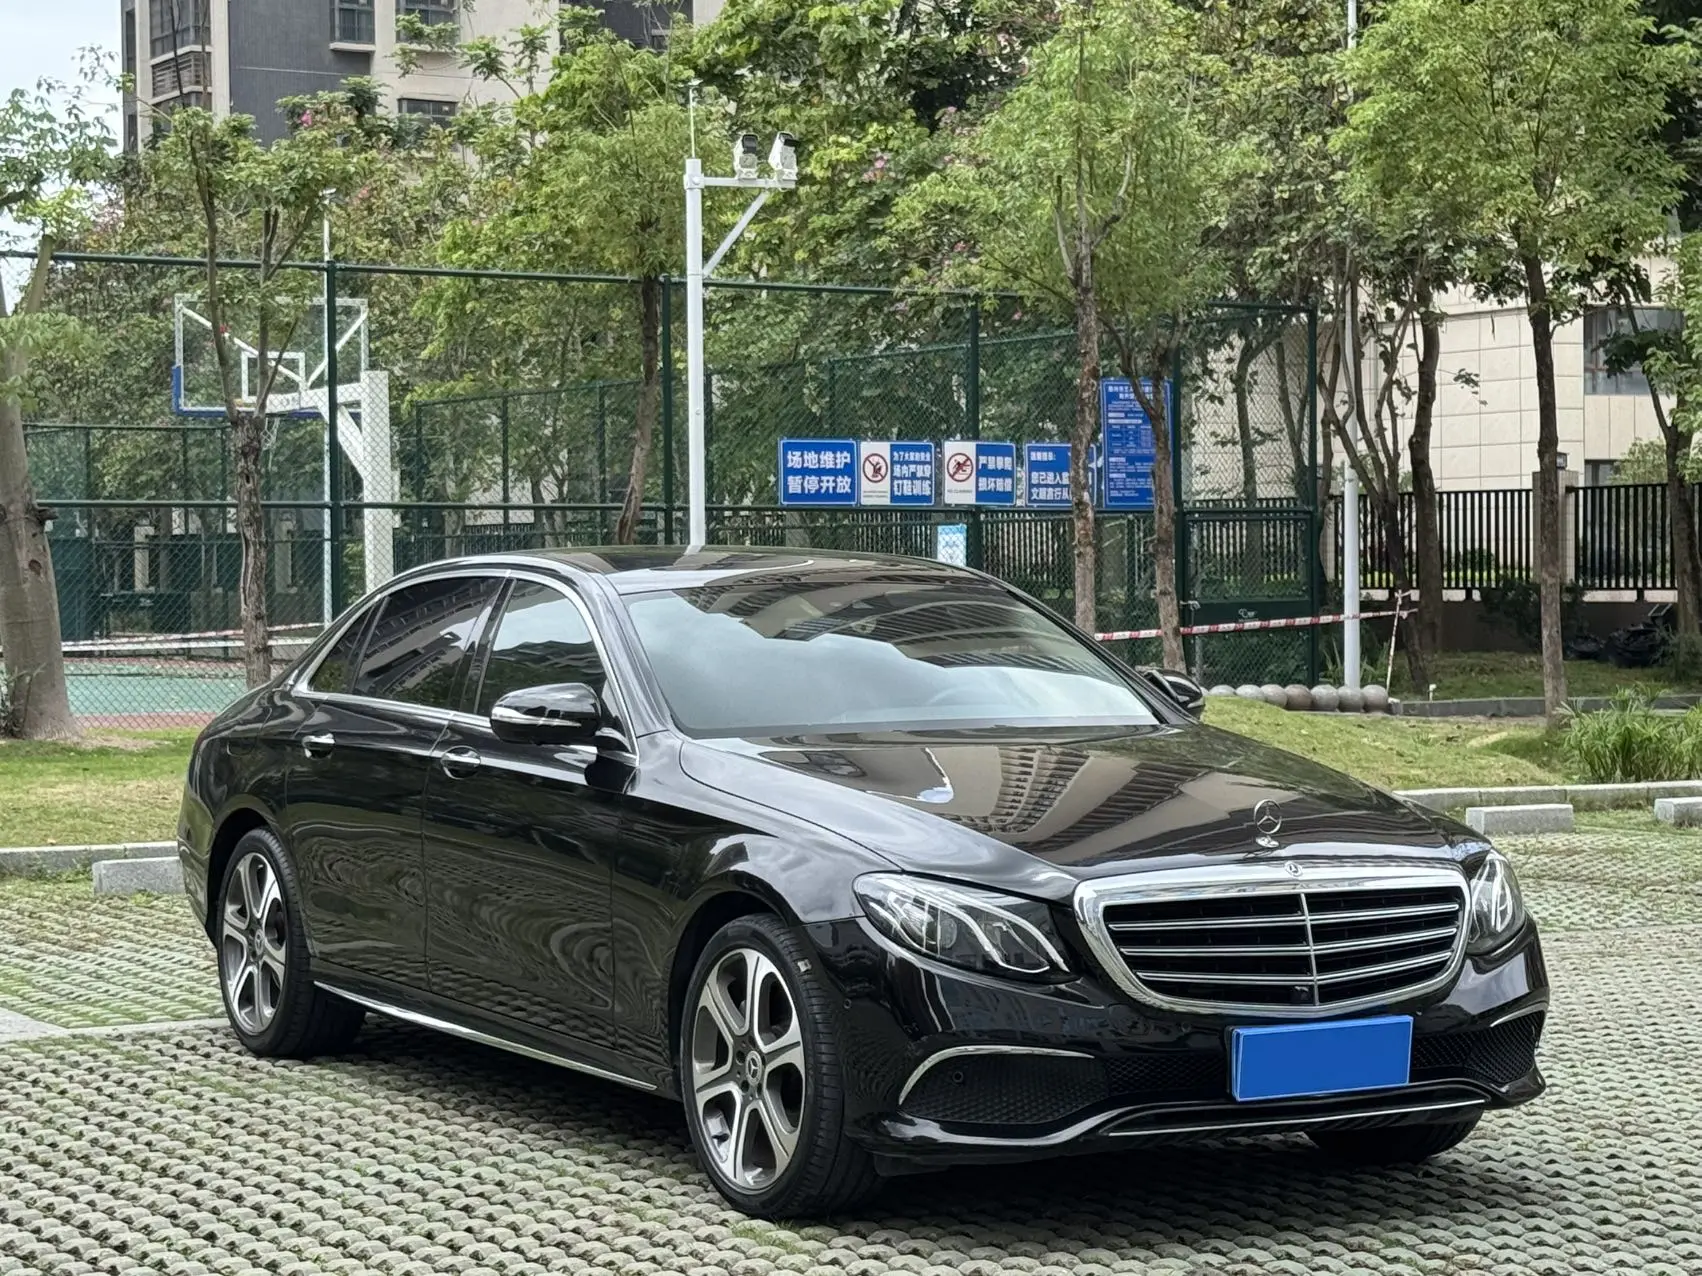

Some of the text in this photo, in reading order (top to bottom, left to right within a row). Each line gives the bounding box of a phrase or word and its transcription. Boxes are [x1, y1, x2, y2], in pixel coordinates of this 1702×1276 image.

[787, 451, 850, 469] 场地维护
[787, 475, 851, 494] 暂停开放
[978, 477, 1012, 492] 损坏赔偿
[1031, 471, 1091, 485] 您已进入监
[893, 479, 931, 496] 钉鞋训练
[1031, 487, 1091, 500] 文明言行从
